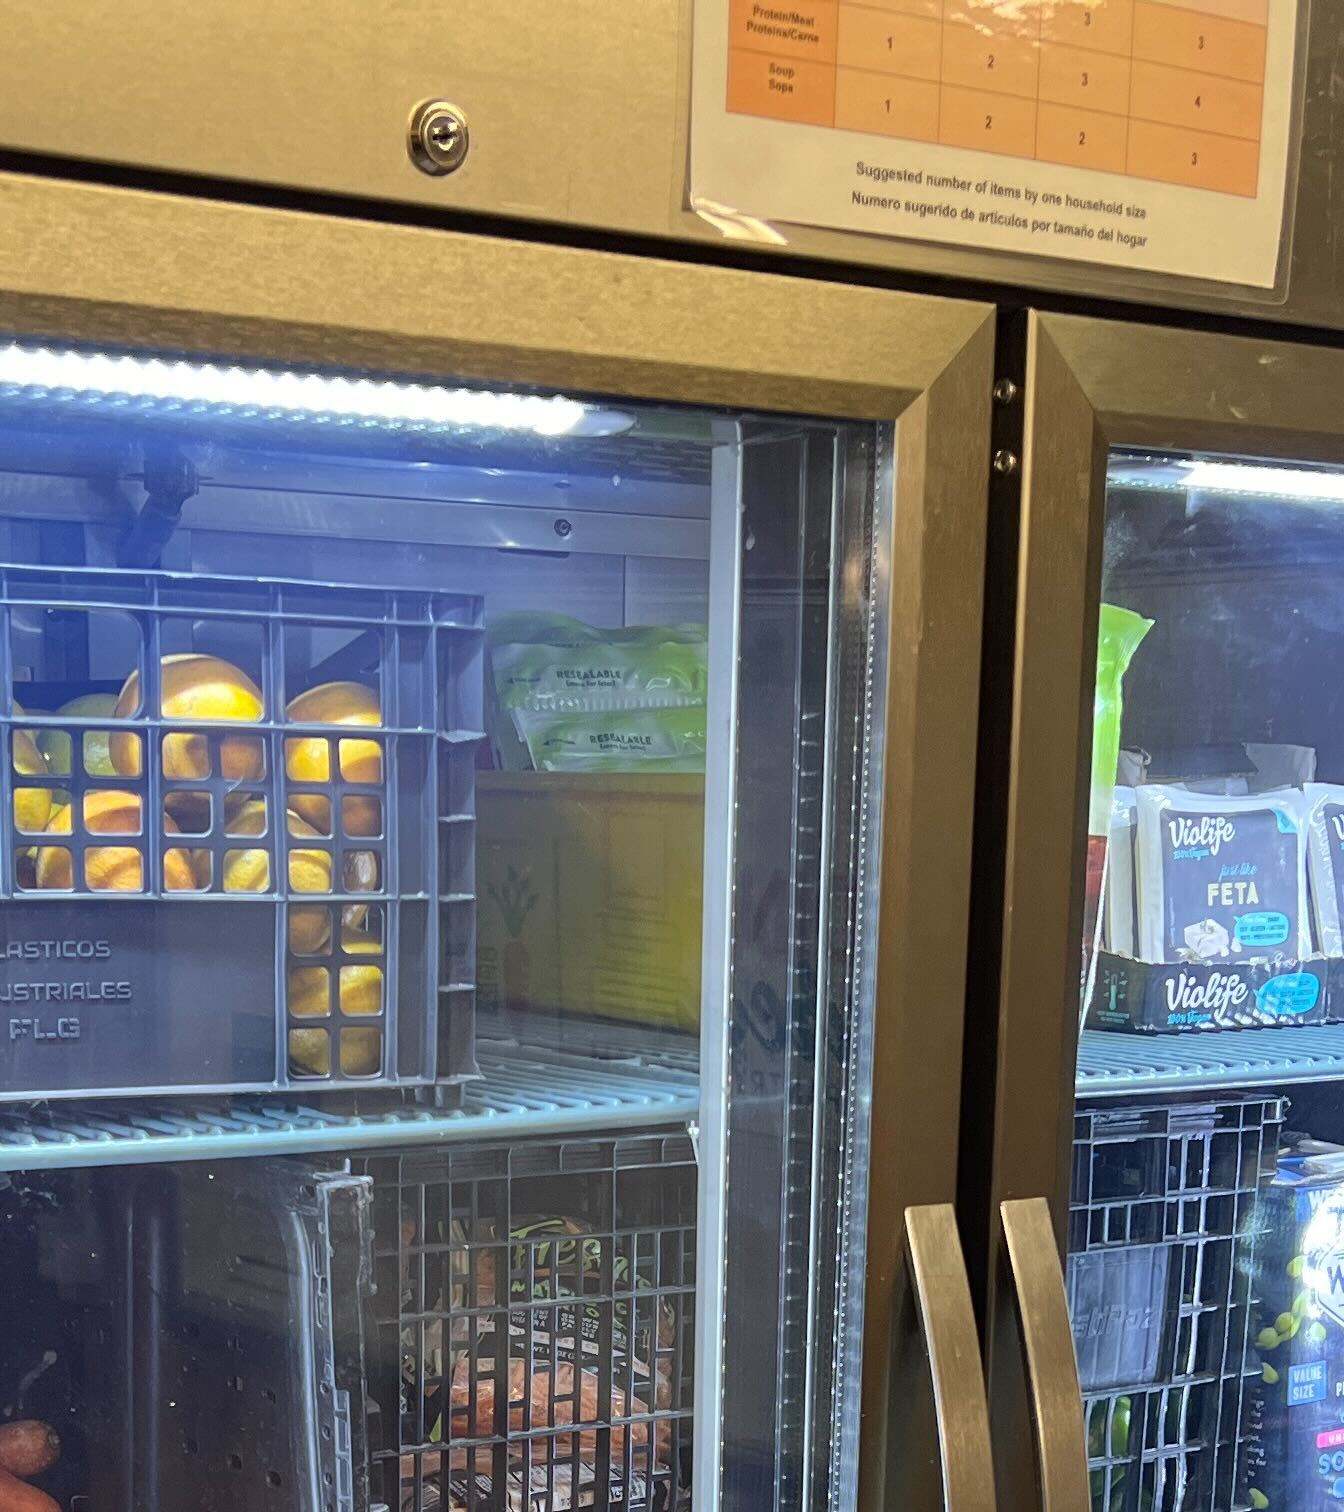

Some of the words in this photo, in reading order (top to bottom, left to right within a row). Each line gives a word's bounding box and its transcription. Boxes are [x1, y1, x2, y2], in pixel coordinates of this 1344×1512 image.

[1084, 12, 1091, 26] 3
[887, 36, 893, 50] 1
[1197, 35, 1204, 50] 3
[987, 54, 995, 69] 2
[769, 62, 794, 79] Soup
[1081, 72, 1088, 86] 3
[885, 99, 891, 113] 1
[1194, 95, 1201, 108] 4
[985, 115, 992, 130] 2
[1079, 131, 1086, 145] 2
[1191, 152, 1198, 166] 3
[856, 160, 923, 184] Suggested
[926, 175, 972, 192] number
[974, 179, 988, 194] of
[990, 181, 1021, 199] items
[1024, 187, 1039, 205] by
[1041, 192, 1062, 206] one
[1065, 194, 1123, 215] household
[1126, 205, 1147, 219] size
[851, 190, 901, 210] Numero
[904, 200, 958, 218] sugerido
[960, 206, 976, 221] de
[1031, 218, 1051, 233] por
[1053, 221, 1095, 239] tamaño
[1097, 228, 1114, 242] del
[1117, 230, 1147, 248] hogar
[556, 668, 622, 681] RESEALABLE
[1168, 816, 1236, 857] Violife
[1207, 881, 1259, 907] FETA
[1165, 972, 1249, 1023] Violife
[1293, 1365, 1323, 1384] VALUE
[1292, 1384, 1315, 1401] SIZE
